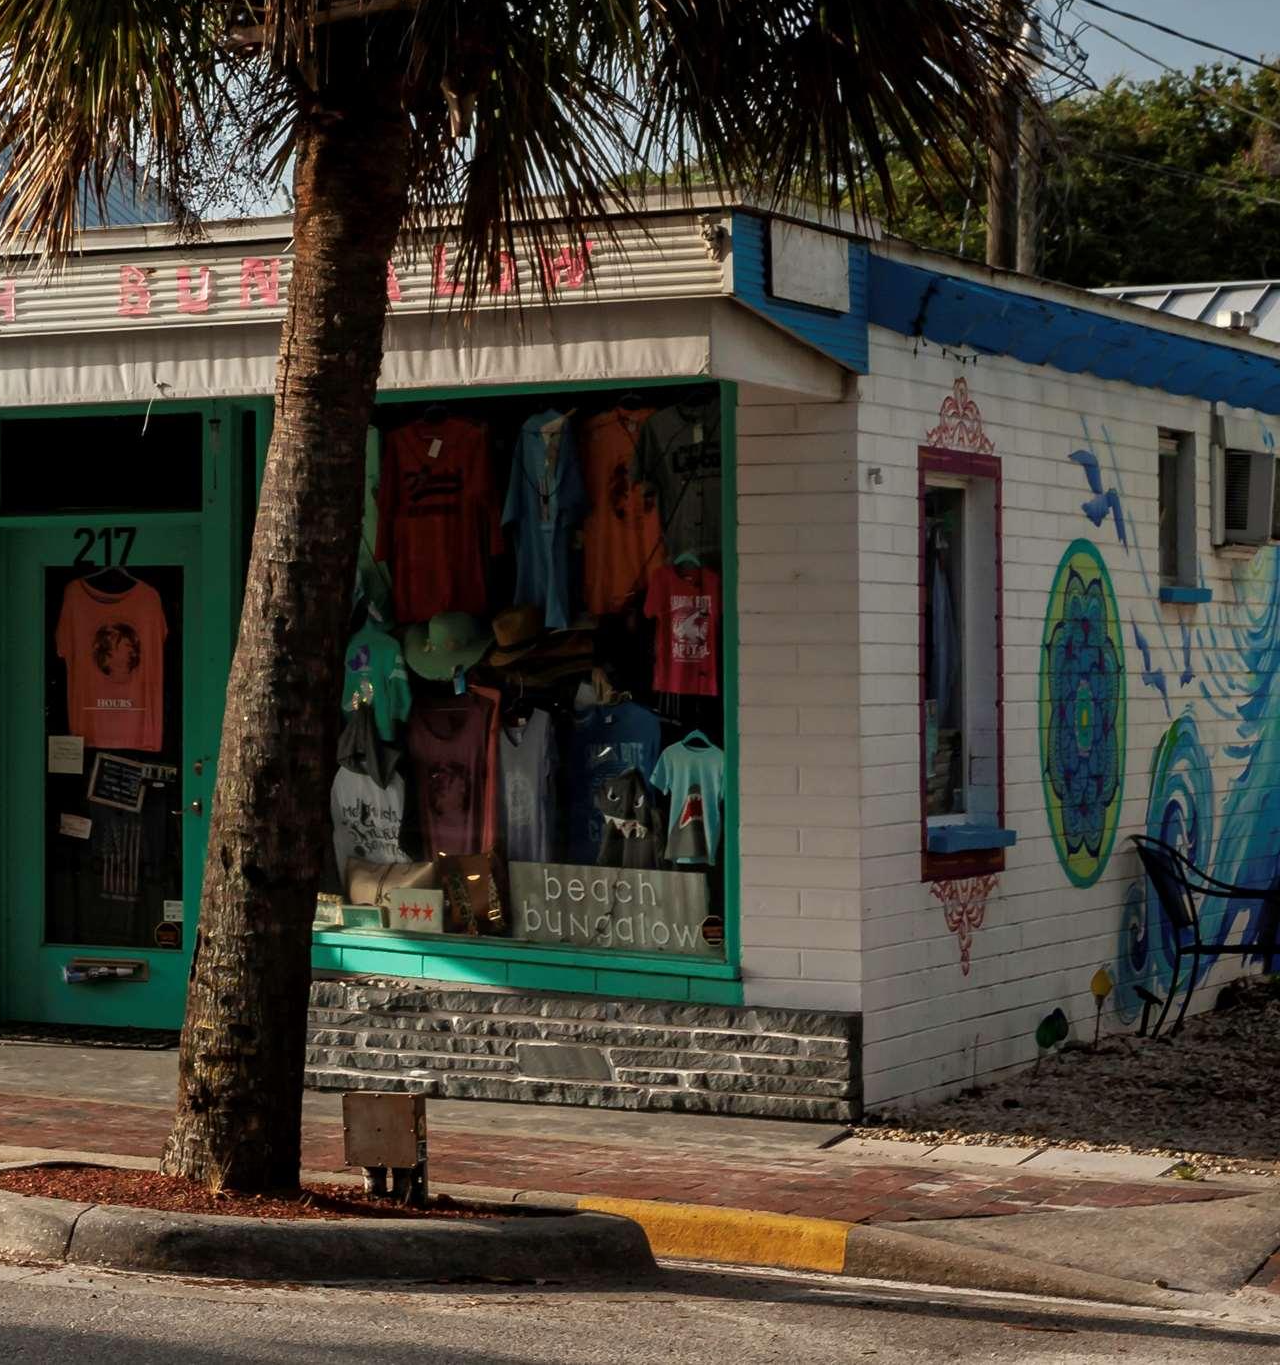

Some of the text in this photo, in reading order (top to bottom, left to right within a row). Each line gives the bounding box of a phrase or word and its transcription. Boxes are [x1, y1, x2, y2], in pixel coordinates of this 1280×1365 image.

[72, 526, 137, 570] 217
[96, 698, 133, 709] HOURS
[543, 868, 657, 907] beach
